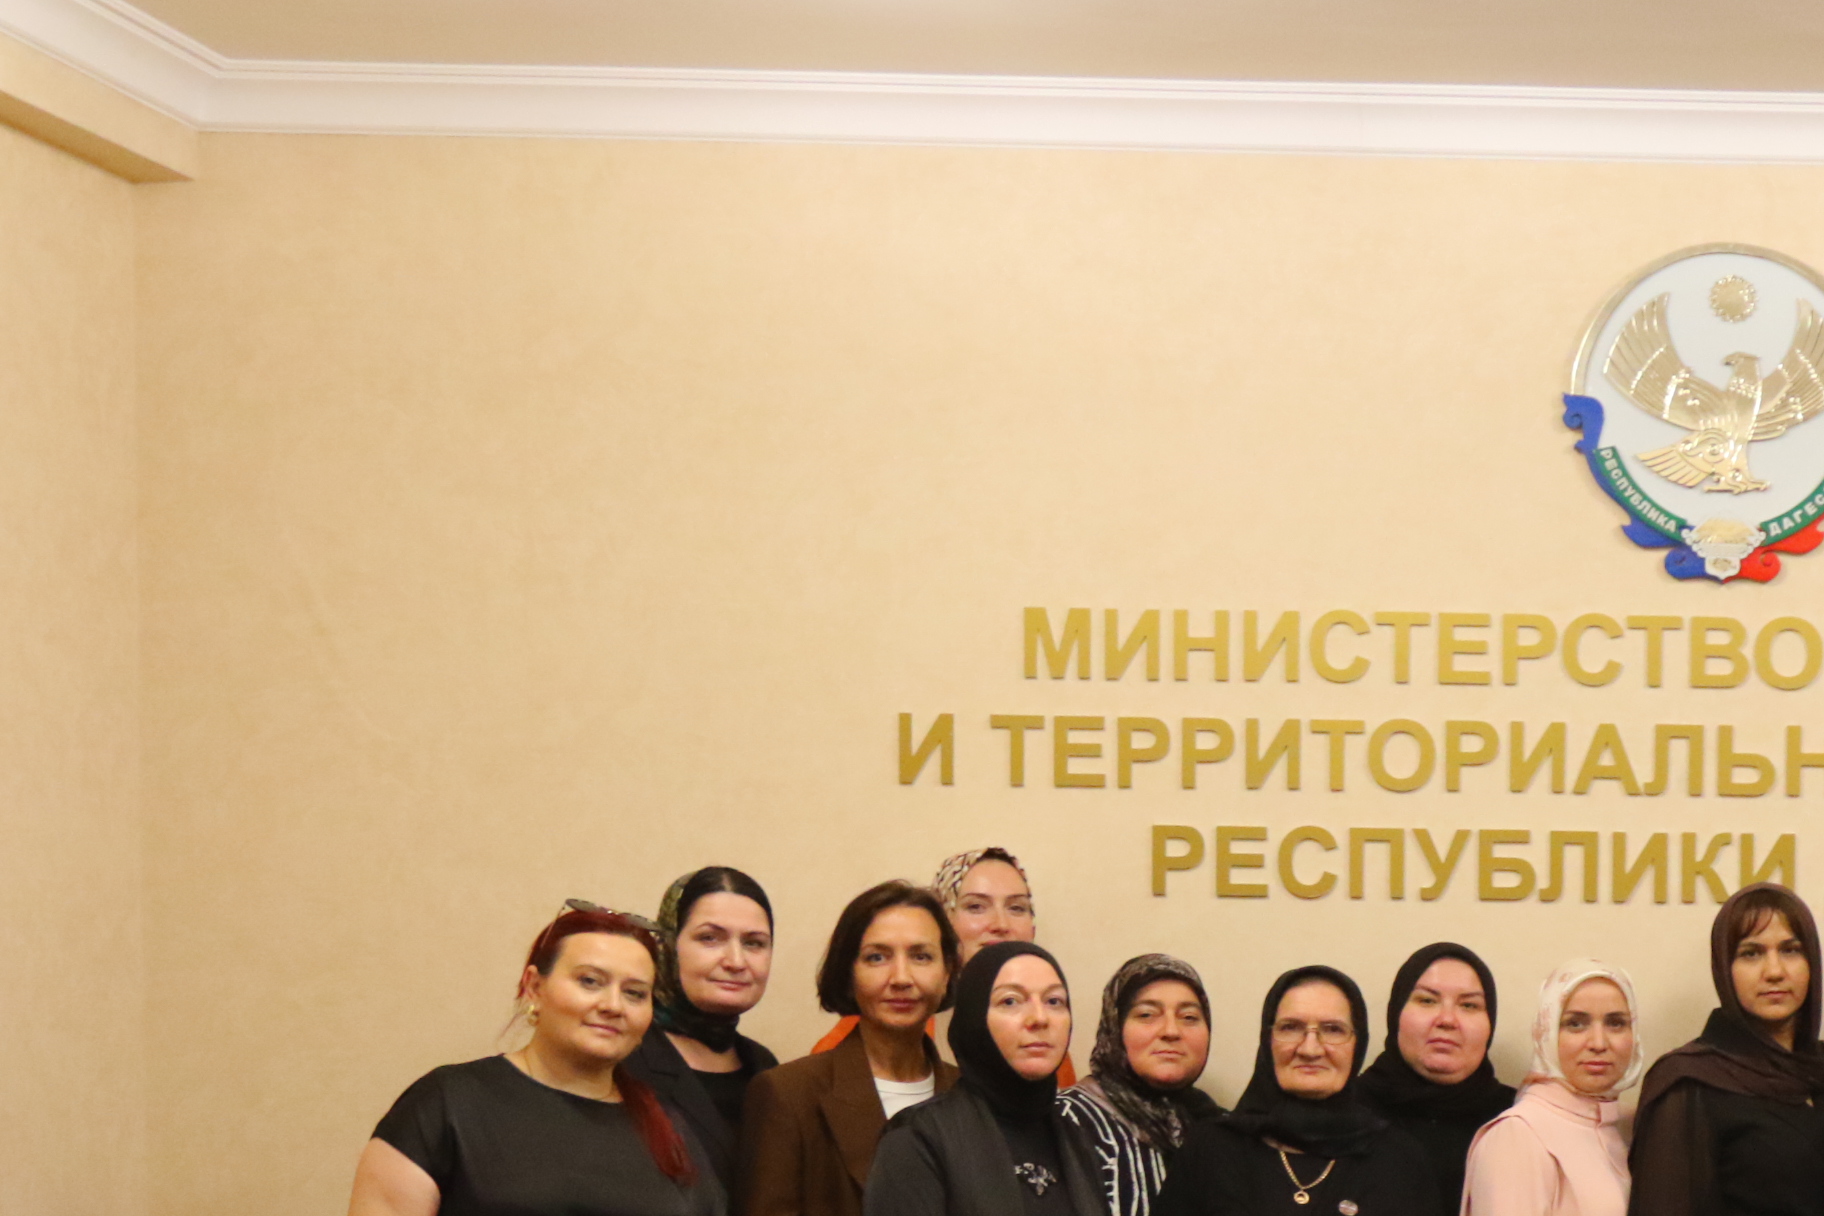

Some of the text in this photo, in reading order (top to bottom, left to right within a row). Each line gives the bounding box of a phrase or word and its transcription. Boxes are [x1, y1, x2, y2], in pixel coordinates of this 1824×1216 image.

[1600, 448, 1677, 533] РЕСПУБЛИКА
[1023, 606, 1824, 691] МИНИСТЕРСТВО
[897, 712, 955, 786] И
[1150, 824, 1796, 905] РЕСПУБЛИКИ
